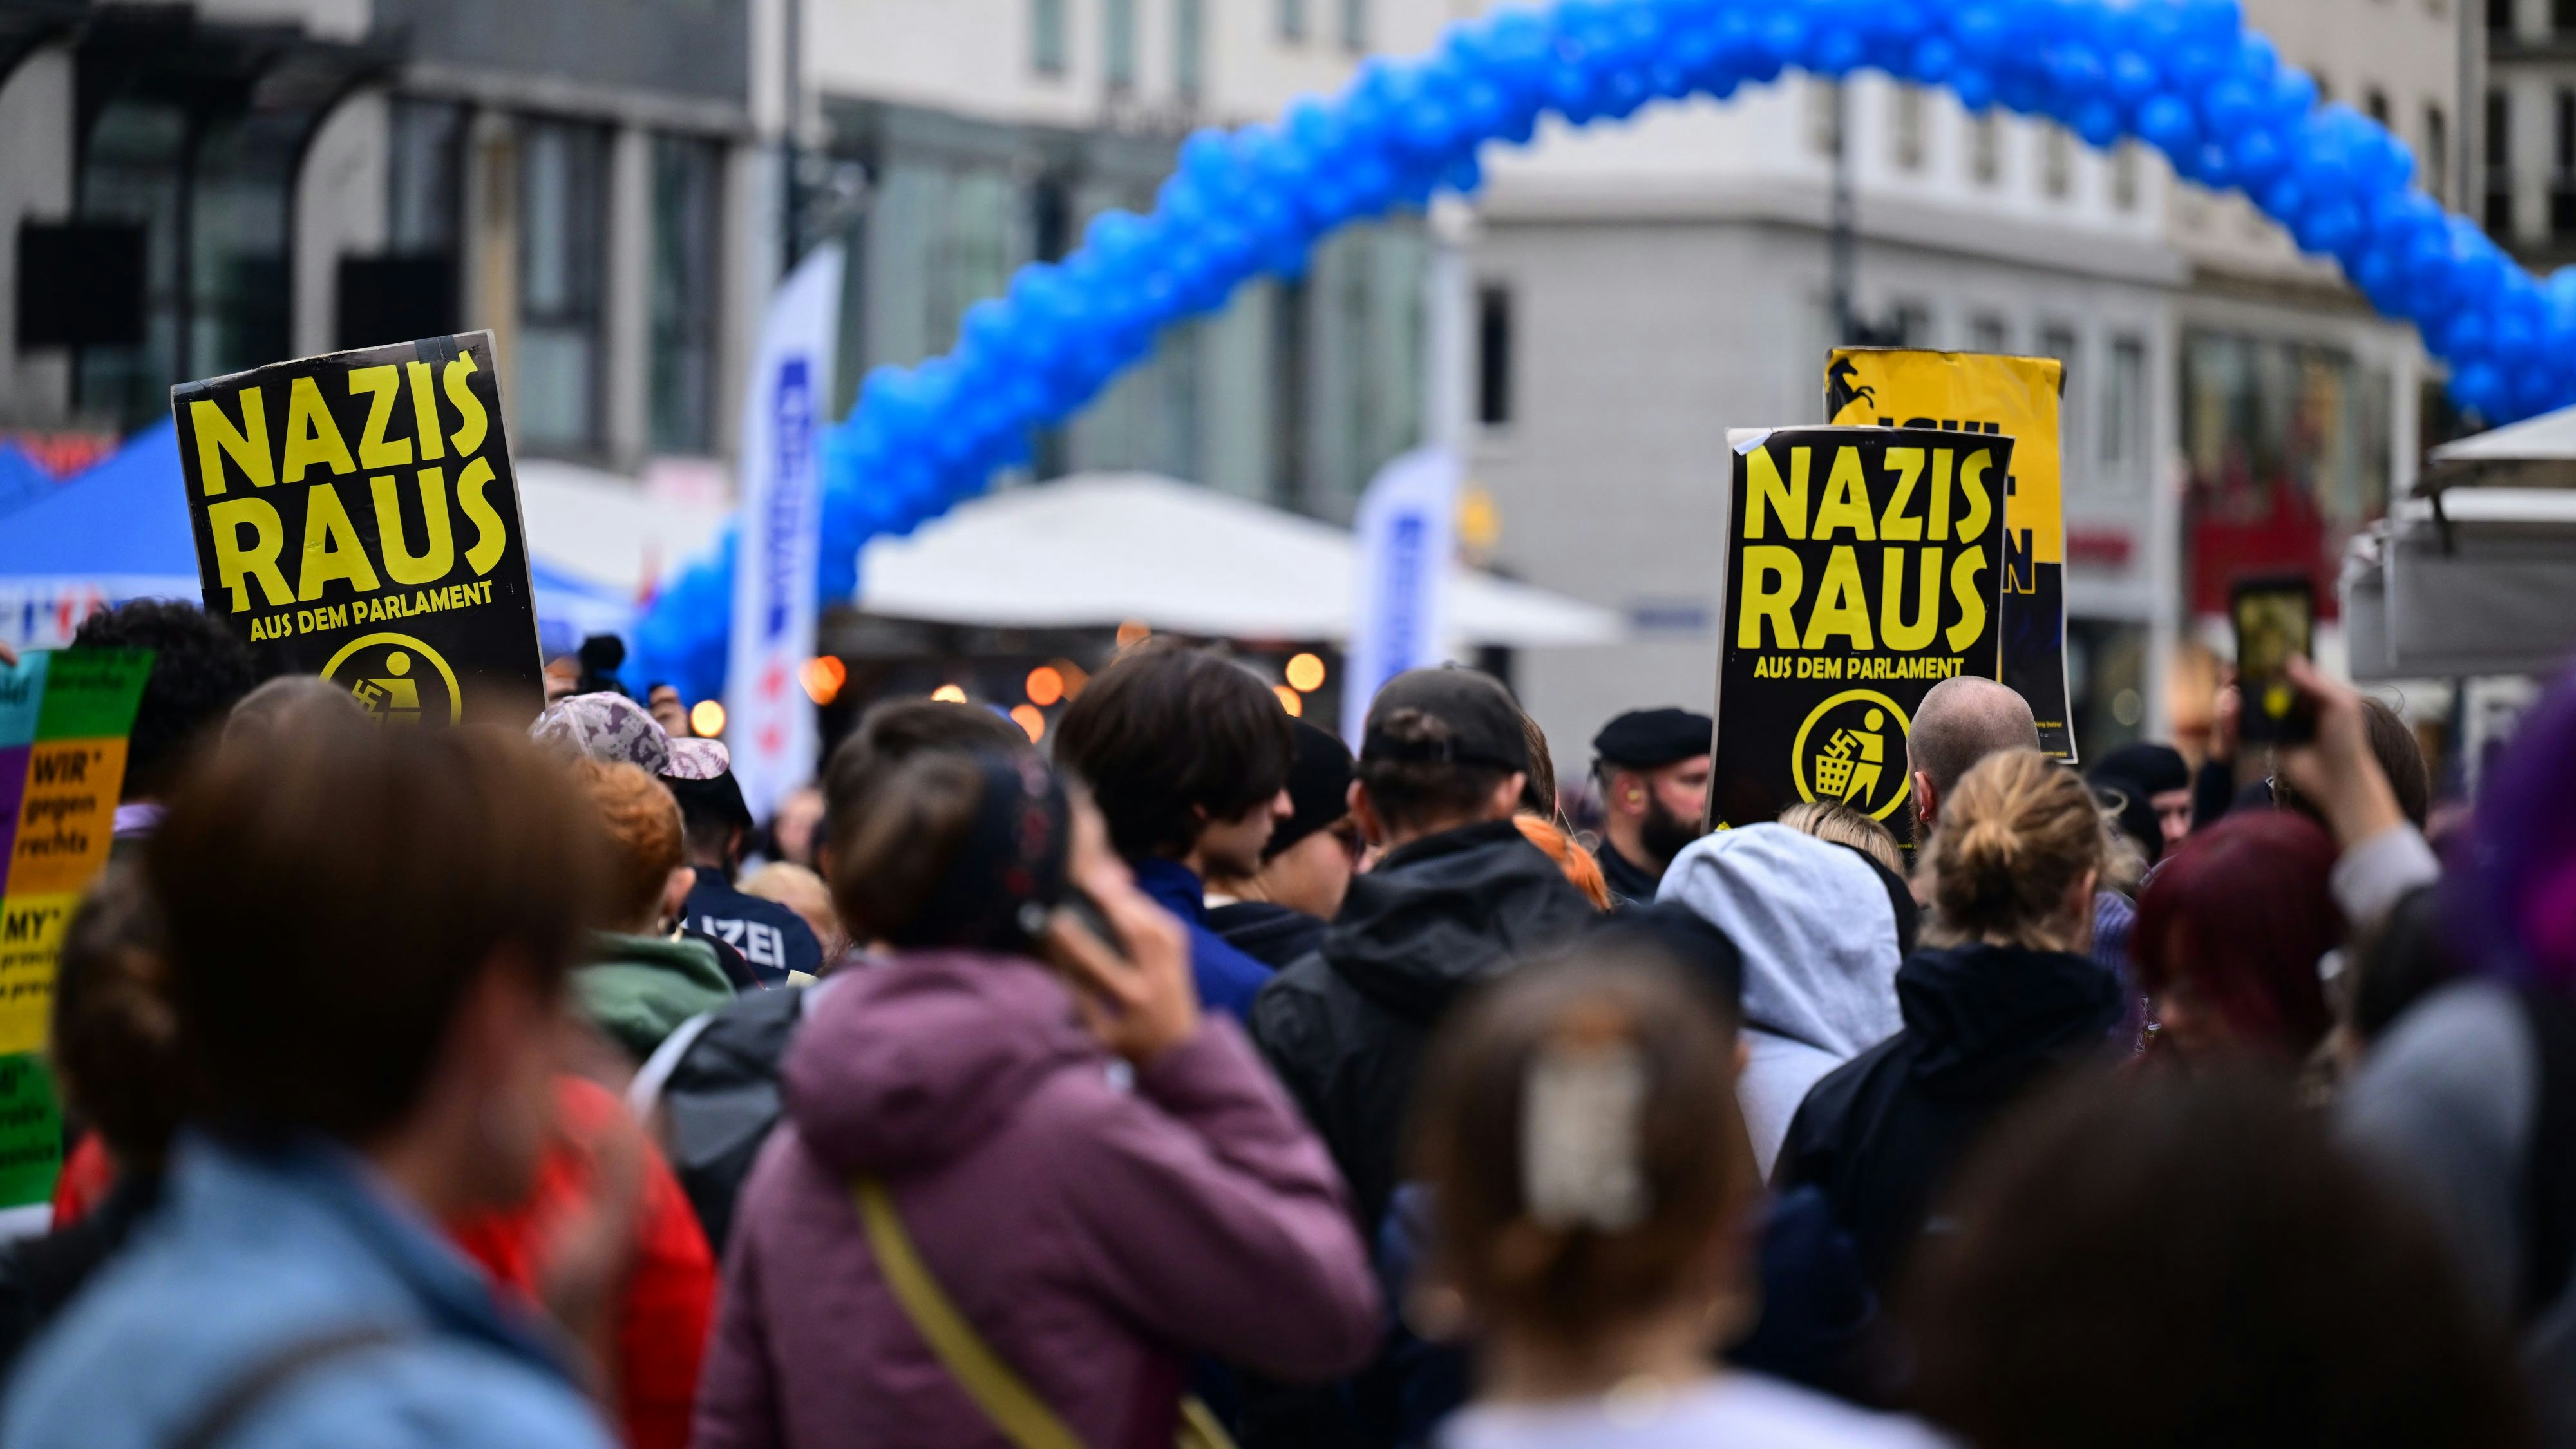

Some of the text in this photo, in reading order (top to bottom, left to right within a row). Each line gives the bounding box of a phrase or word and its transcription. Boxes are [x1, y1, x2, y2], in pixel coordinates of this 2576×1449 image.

[190, 351, 488, 497] NAZIS
[208, 456, 506, 613] RAUS
[1743, 444, 1996, 544] NAZIS
[251, 580, 493, 642] AUS DEM PARLAMENT
[1737, 545, 1987, 653] RAUS
[1754, 656, 1964, 679] AUS DEM PARLAMENT
[17, 829, 88, 858] rechts
[26, 796, 96, 825] gegen
